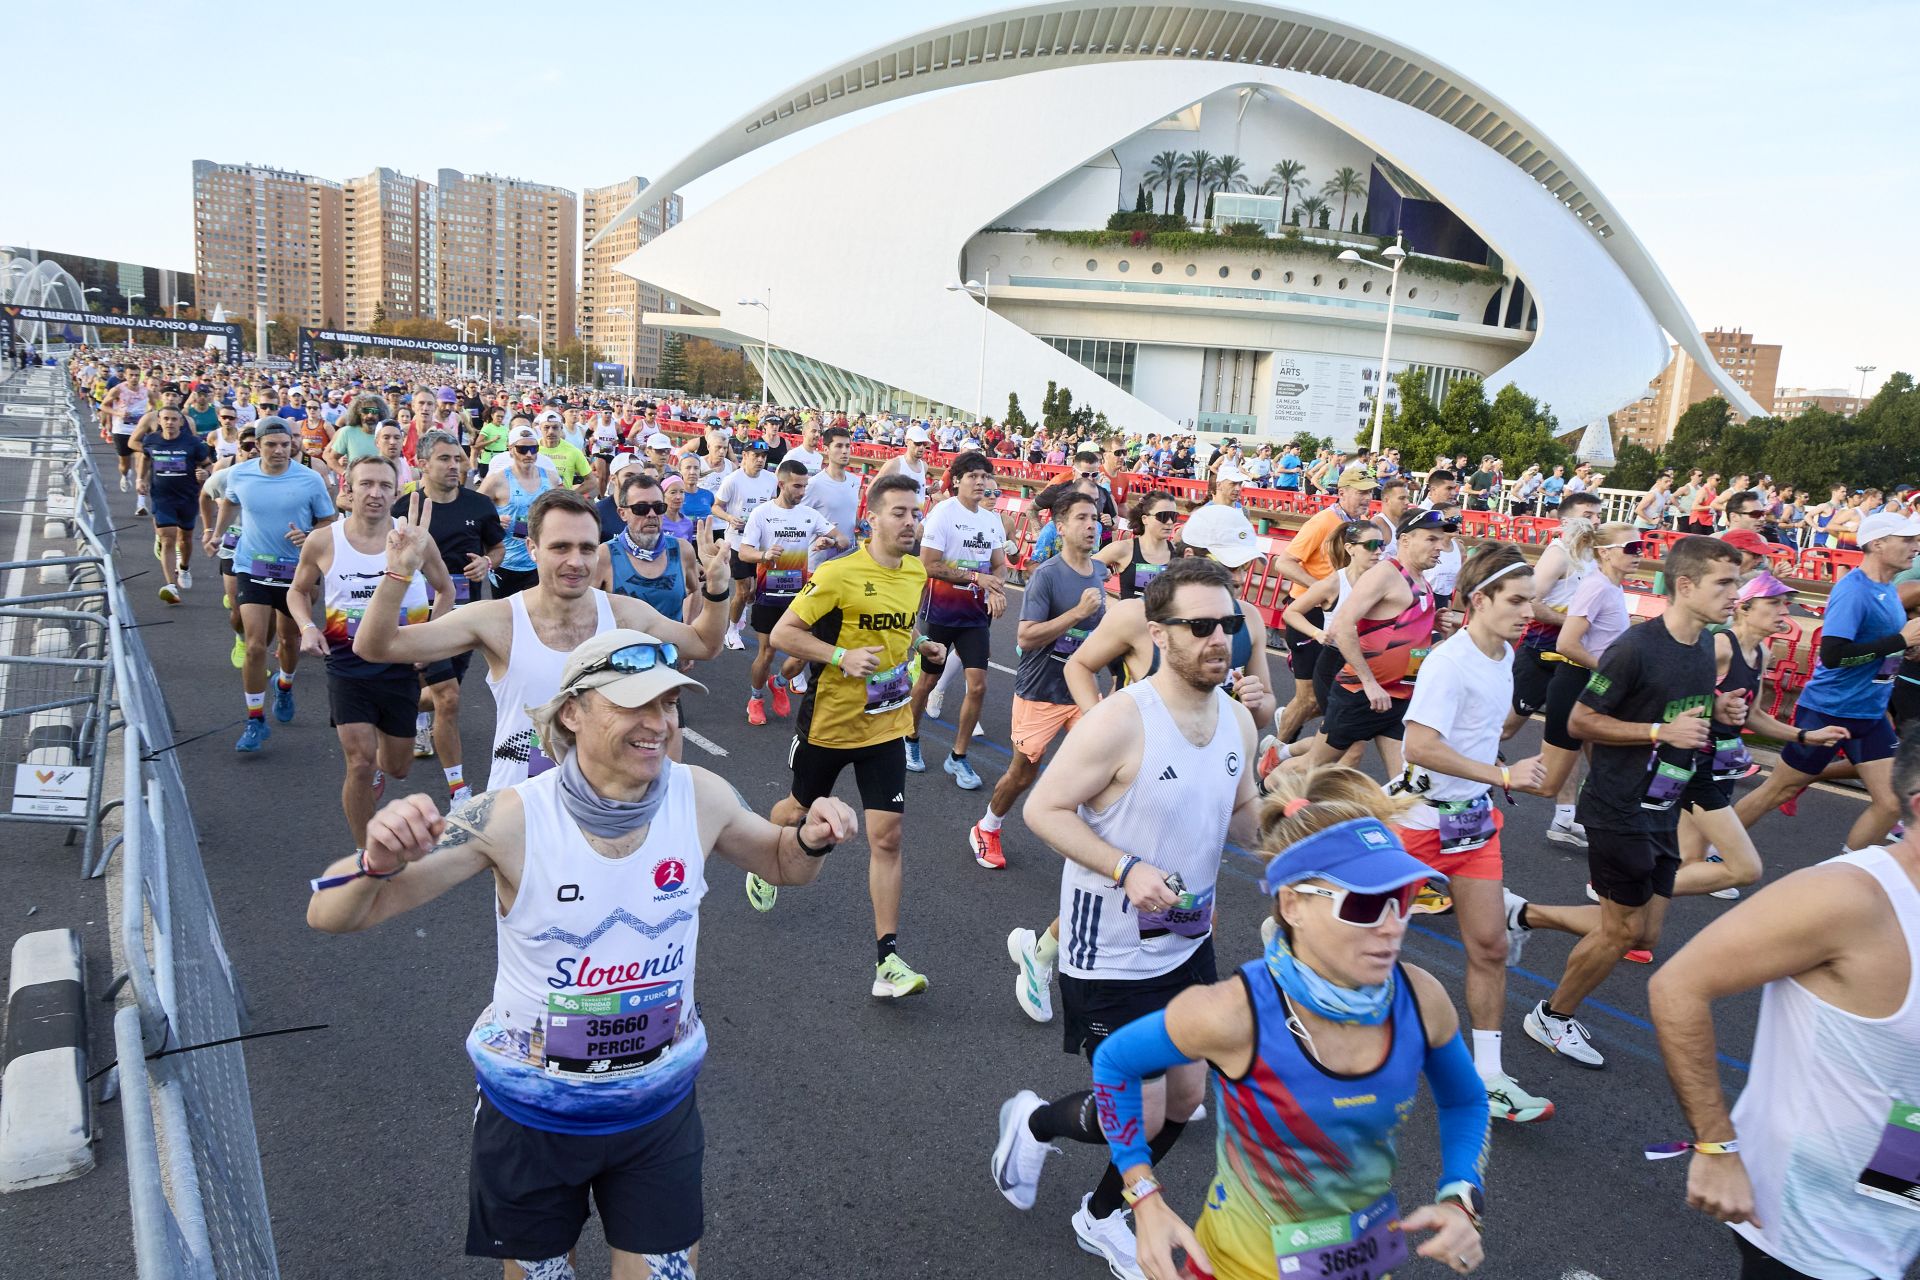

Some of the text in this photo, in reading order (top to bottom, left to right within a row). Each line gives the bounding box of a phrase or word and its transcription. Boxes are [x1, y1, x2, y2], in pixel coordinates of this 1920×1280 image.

[20, 308, 39, 318] 42K
[40, 309, 82, 322] VALENCIA
[84, 314, 135, 327] TRINIDAD
[136, 318, 187, 330] ALFONSO
[320, 331, 336, 340] 42K
[336, 333, 372, 344] VALENCIA
[372, 336, 415, 349] TRINIDAD
[416, 341, 459, 352] ALFONSO
[1280, 367, 1301, 376] ARTS
[1281, 358, 1295, 367] LES
[774, 530, 807, 538] MARATHON
[963, 539, 992, 549] MARATHON
[351, 590, 375, 599] MARA
[858, 611, 918, 631] REDOLA
[547, 943, 685, 990] Slovenia
[586, 1014, 649, 1038] 35660
[586, 1036, 646, 1057] PERCIC
